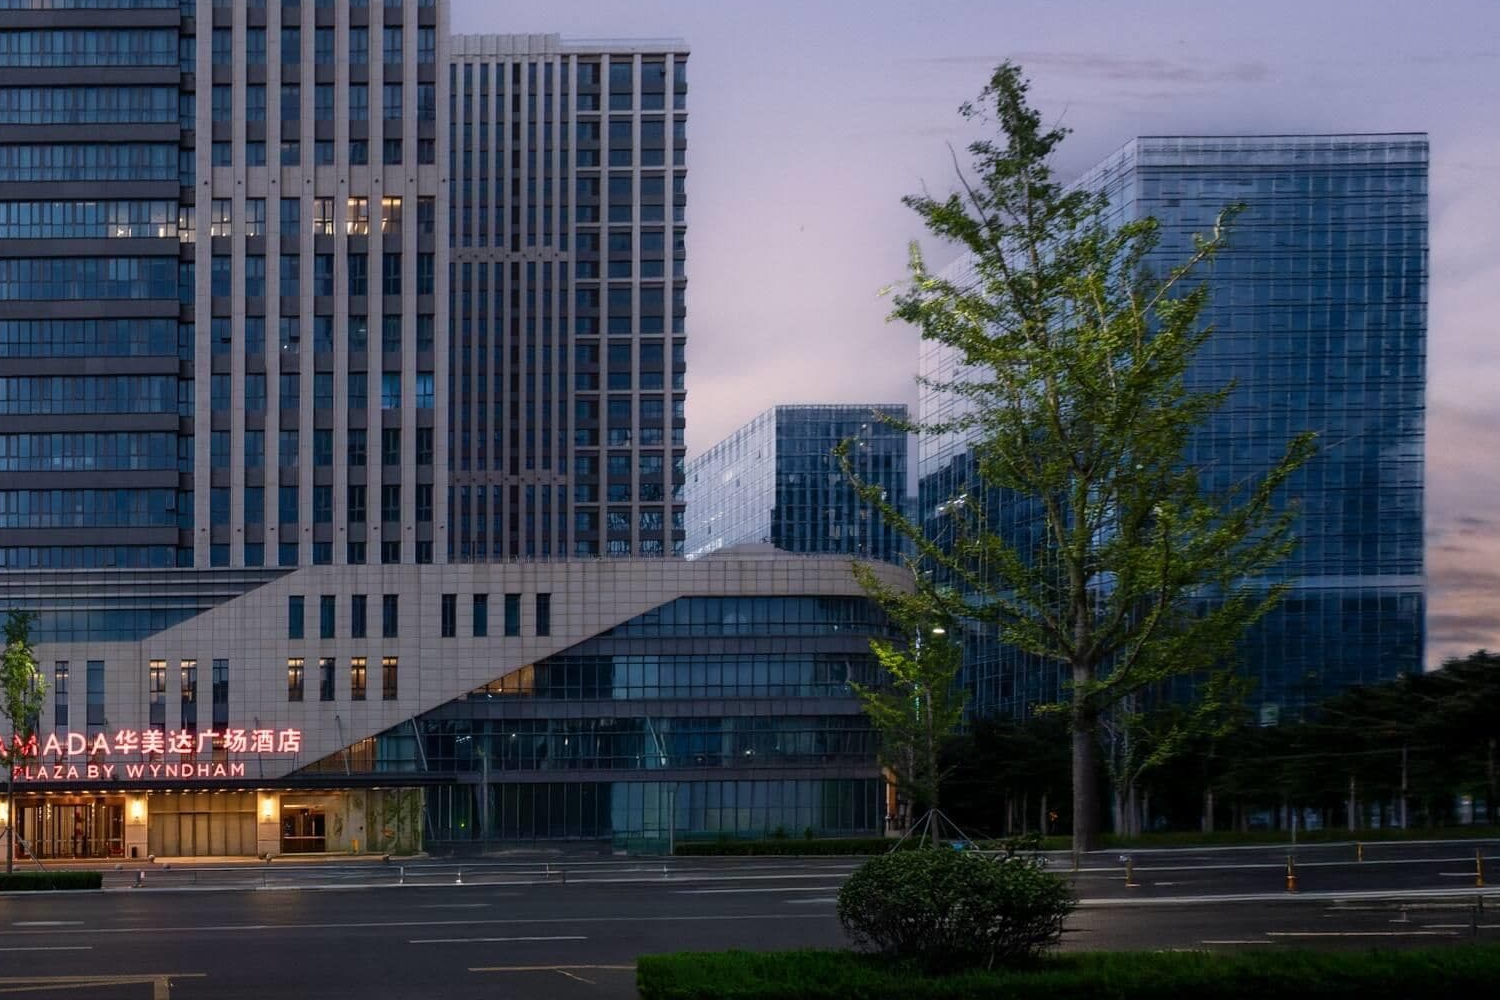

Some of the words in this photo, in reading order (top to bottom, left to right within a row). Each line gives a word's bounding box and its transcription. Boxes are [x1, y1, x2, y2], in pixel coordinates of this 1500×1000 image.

[114, 728, 301, 755] 华美达广场酒店
[87, 764, 115, 779] BY
[126, 763, 245, 778] WYNDHAM
